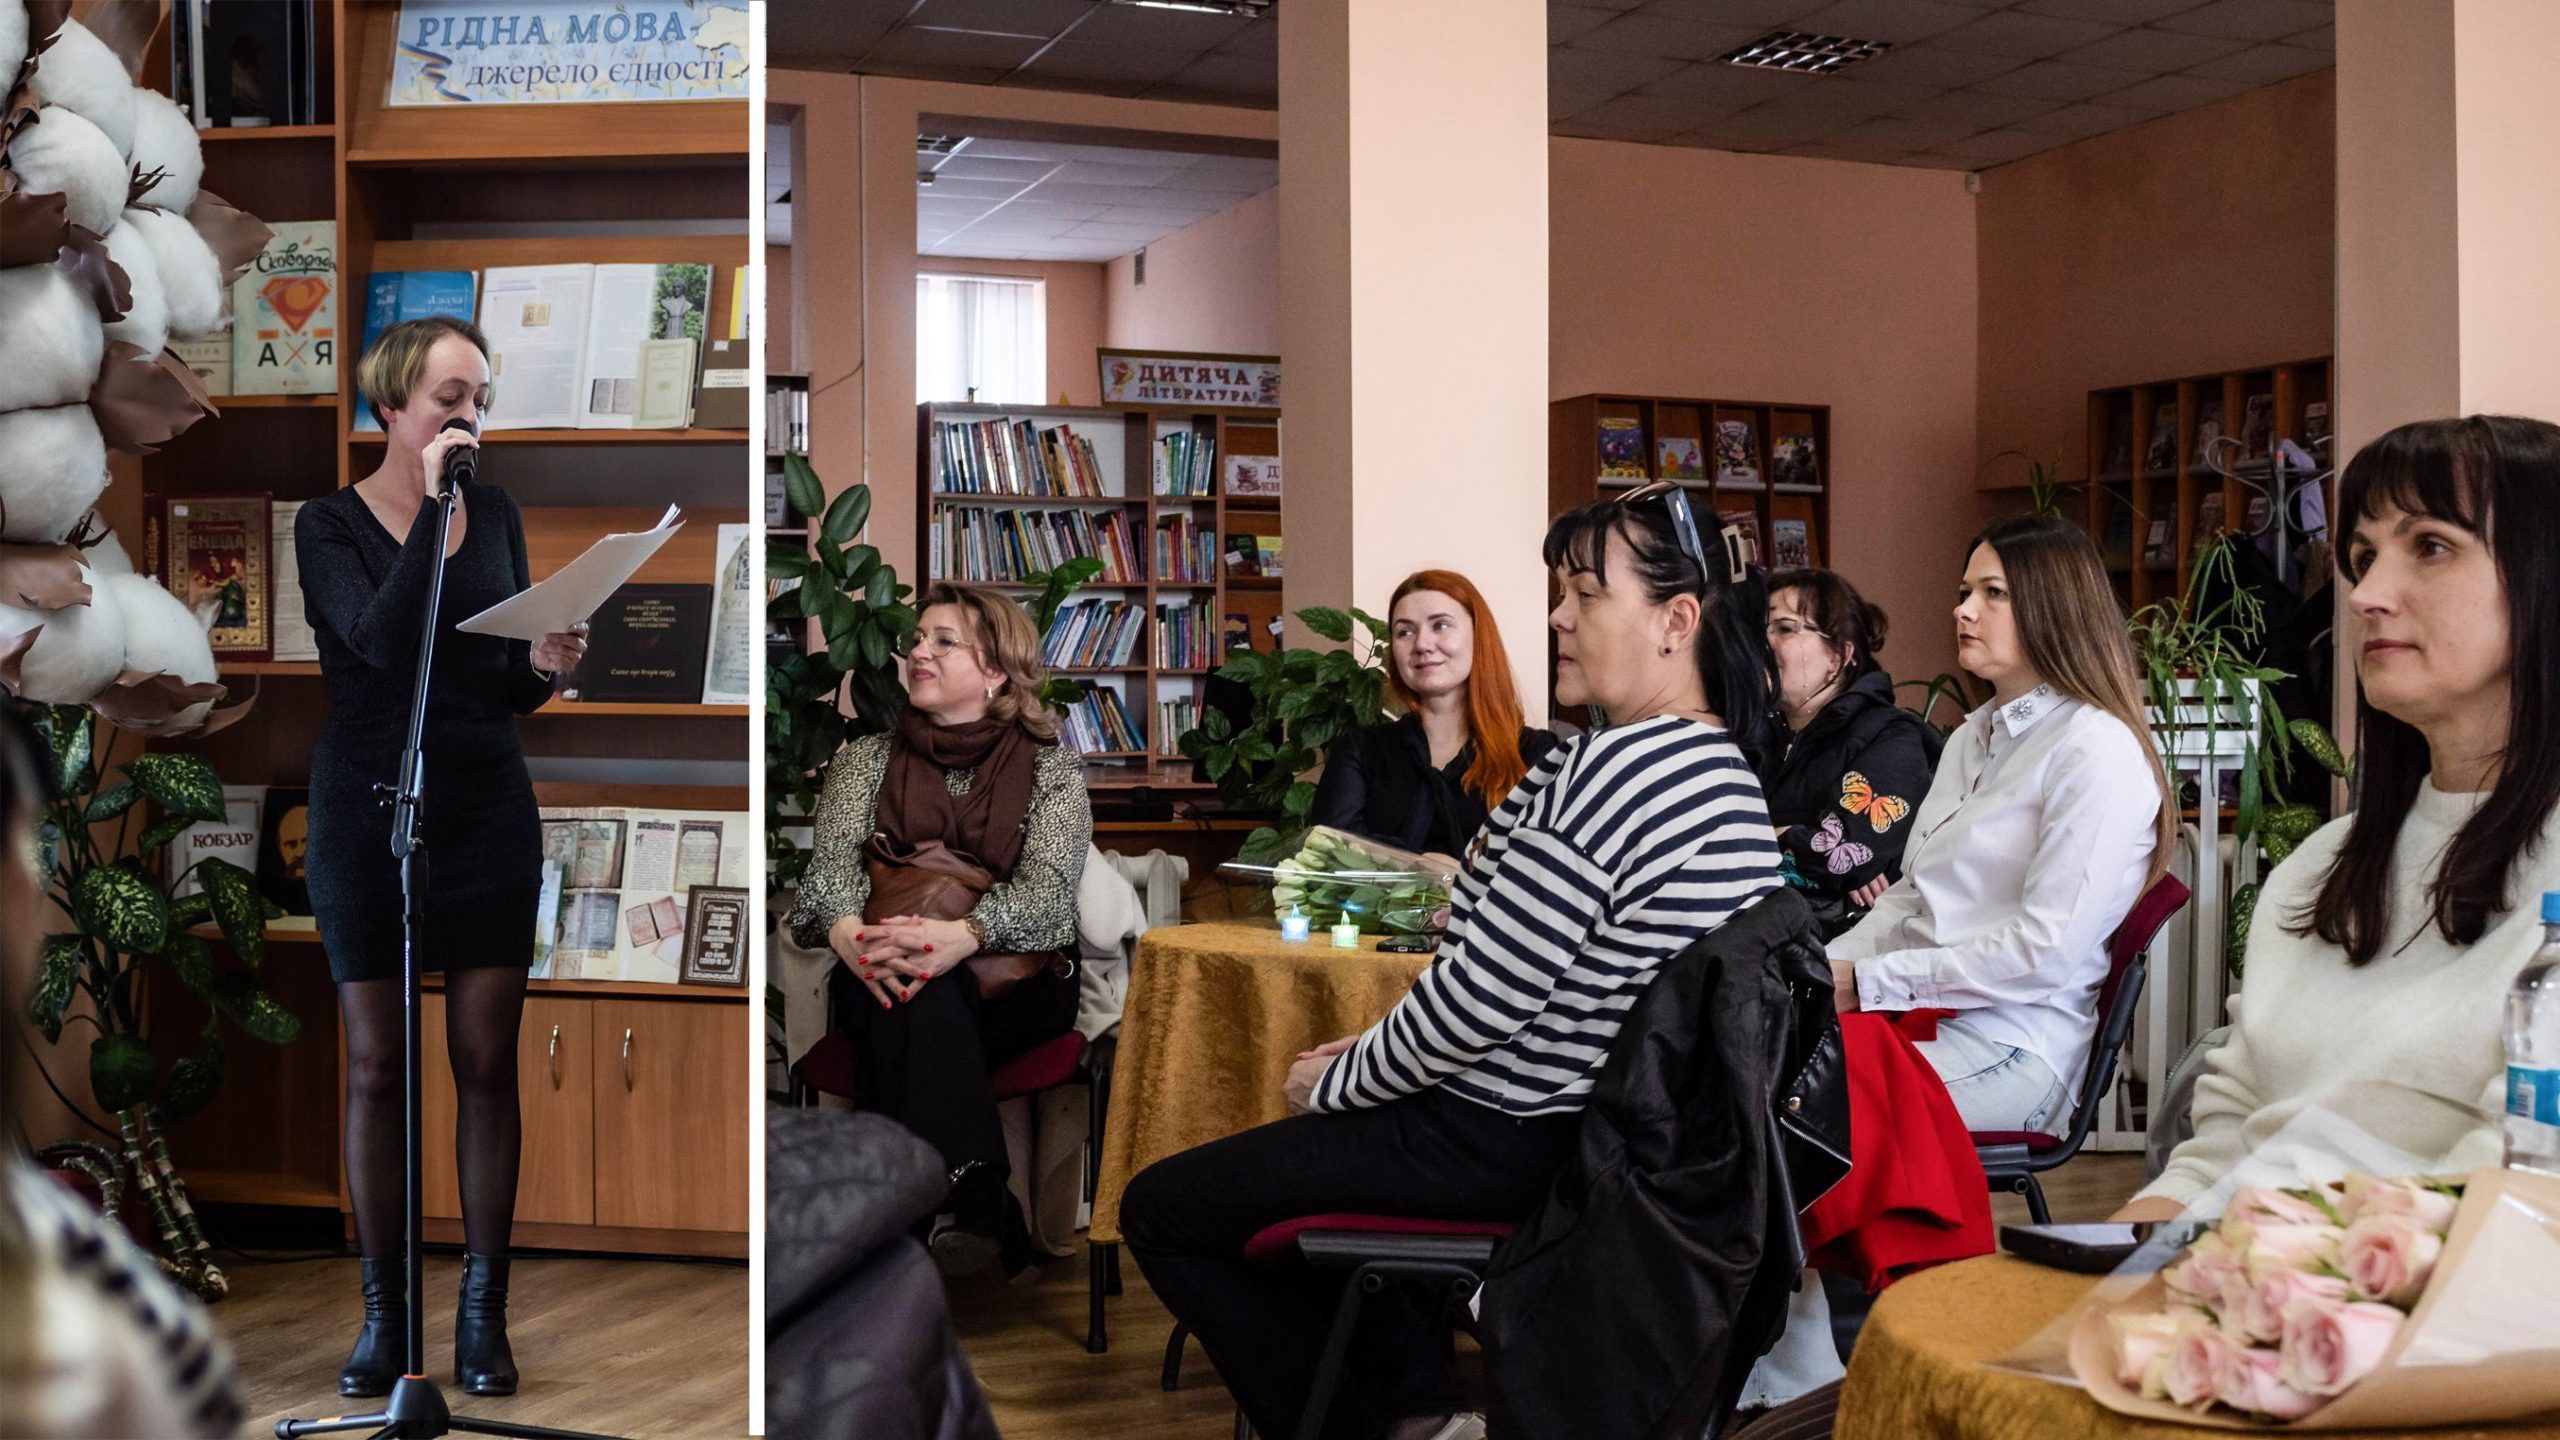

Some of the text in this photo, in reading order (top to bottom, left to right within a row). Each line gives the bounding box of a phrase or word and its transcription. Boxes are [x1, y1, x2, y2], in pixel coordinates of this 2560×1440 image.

[416, 16, 548, 50] РІДНА
[465, 51, 725, 91] джерело єдності
[257, 340, 332, 367] А Я
[1138, 364, 1250, 386] ДИТЯЧА
[1137, 386, 1252, 402] ЛІТЕРАТУРА
[192, 832, 253, 849] КОБЗАР
